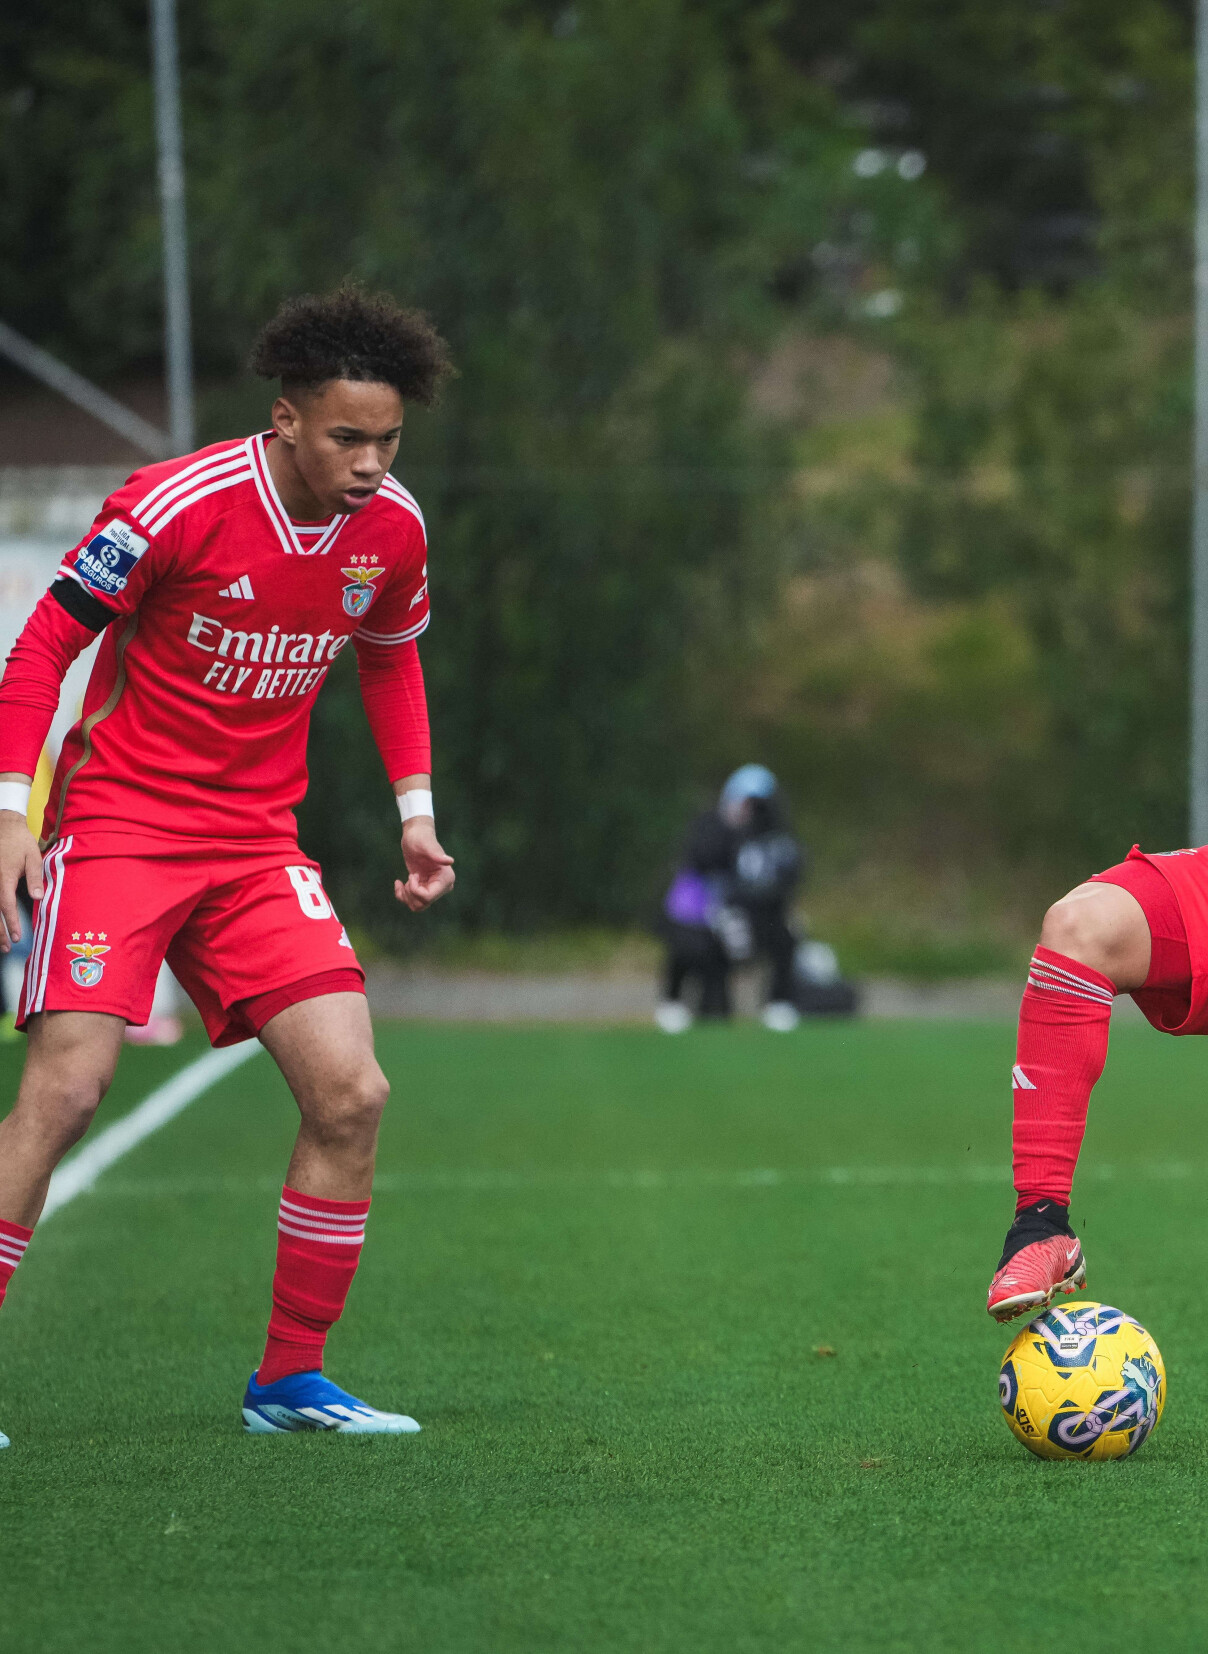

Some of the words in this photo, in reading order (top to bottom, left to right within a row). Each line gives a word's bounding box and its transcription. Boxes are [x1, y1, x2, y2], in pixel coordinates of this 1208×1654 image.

[109, 528, 129, 550] PORTUGAL
[119, 529, 131, 541] LIGA
[78, 547, 128, 590] SABSEG
[80, 563, 113, 590] SEGUROS
[187, 612, 351, 663] Emirate
[202, 661, 253, 694] FLY
